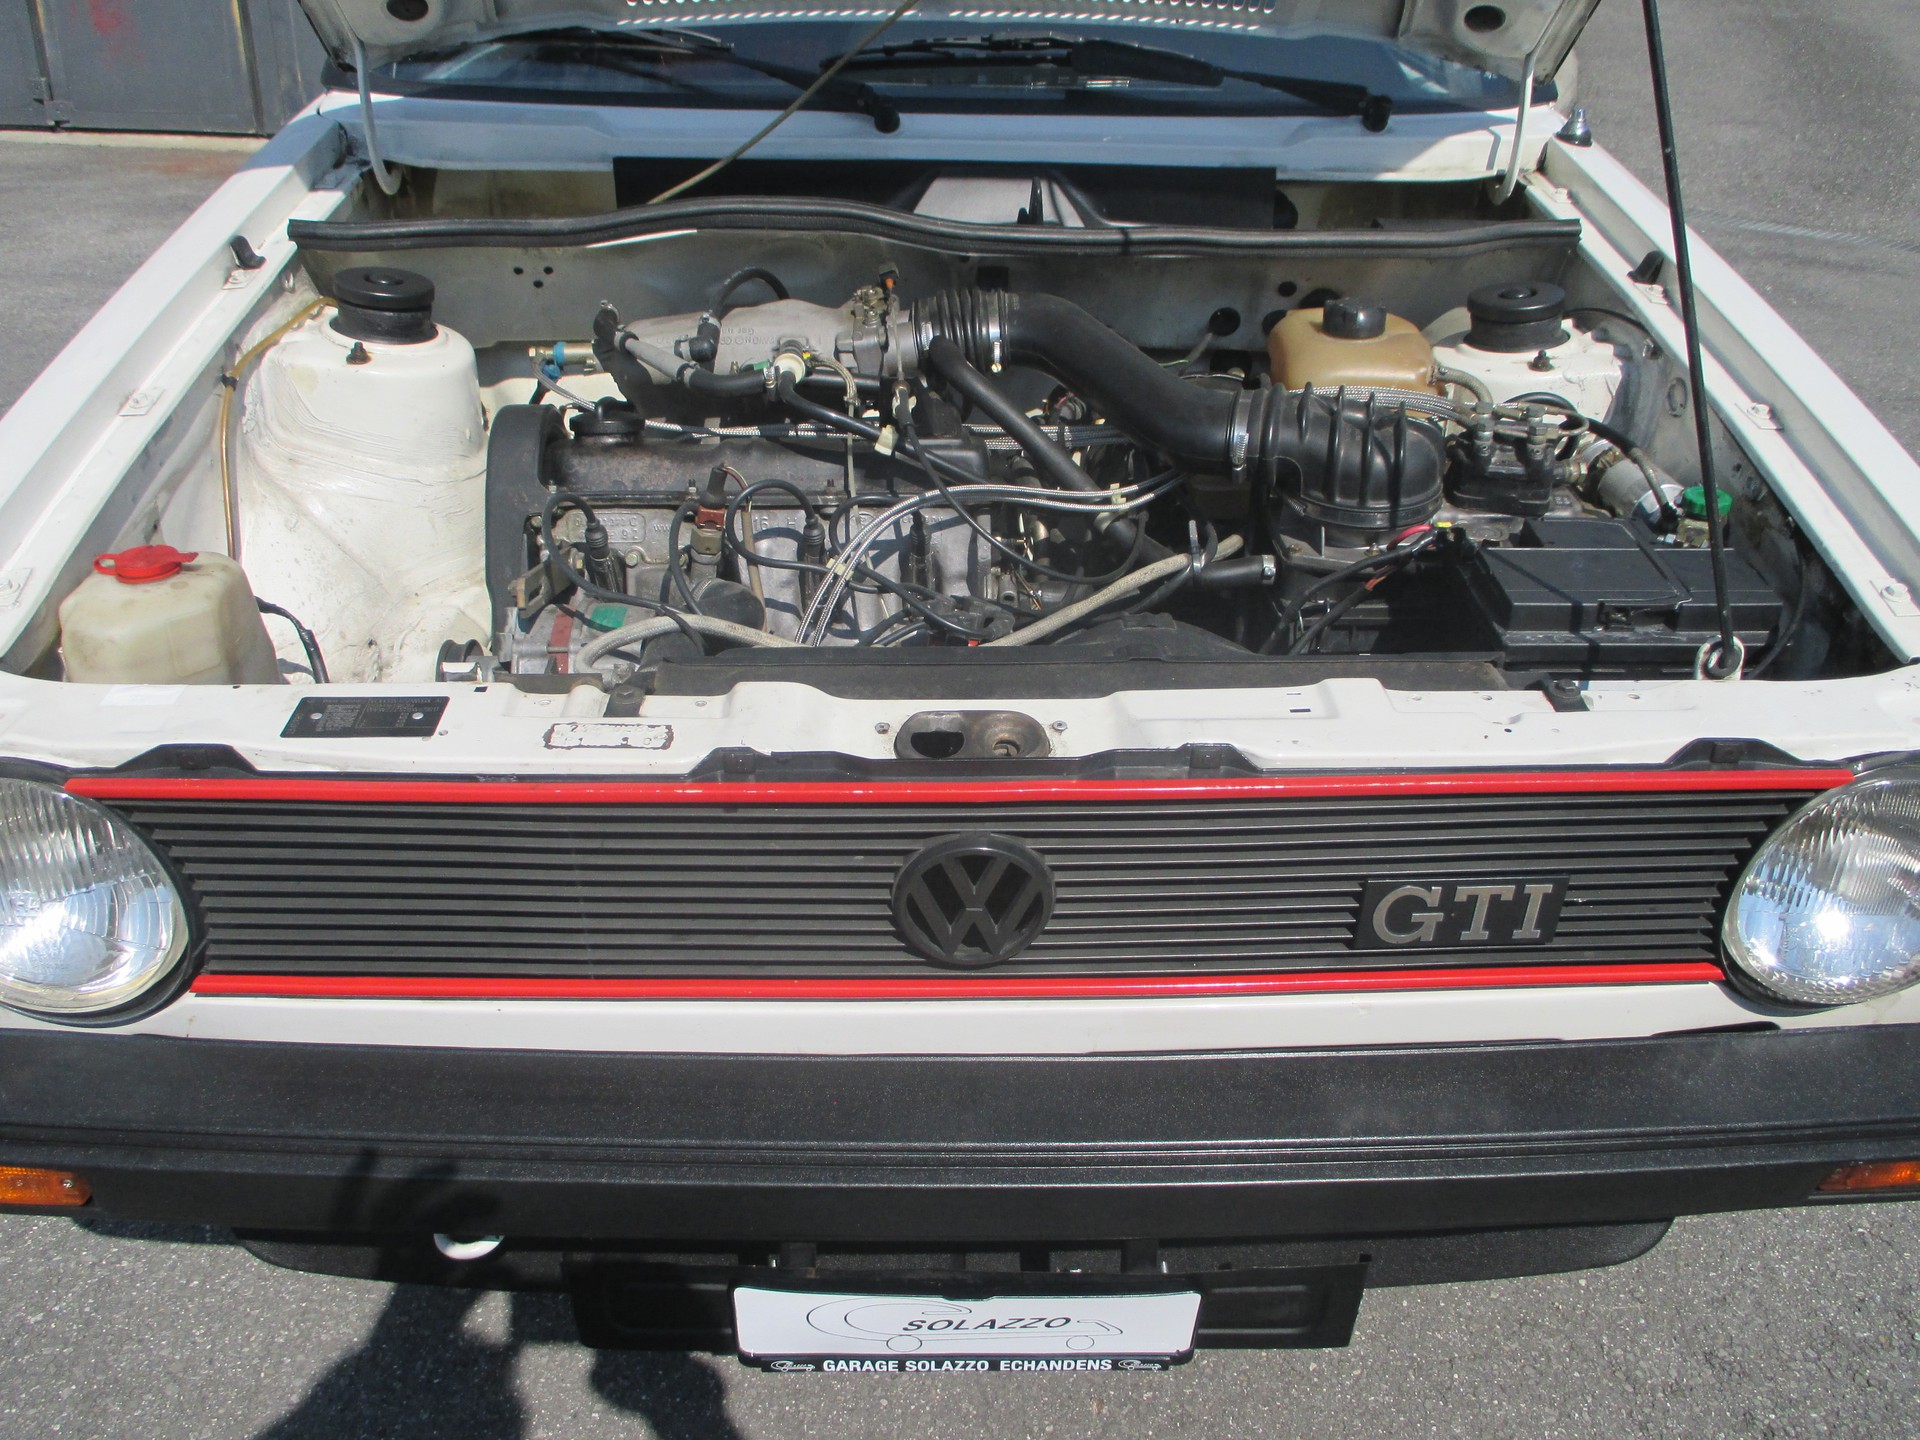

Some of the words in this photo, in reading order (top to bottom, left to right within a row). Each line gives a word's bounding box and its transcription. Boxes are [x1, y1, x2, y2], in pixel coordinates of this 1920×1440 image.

[1372, 884, 1553, 945] GTI
[902, 1316, 1072, 1332] SOLAZZO
[822, 1359, 899, 1372] GARAGE
[905, 1359, 989, 1372] SOLAZZO
[1000, 1359, 1112, 1371] ECHANDENS
